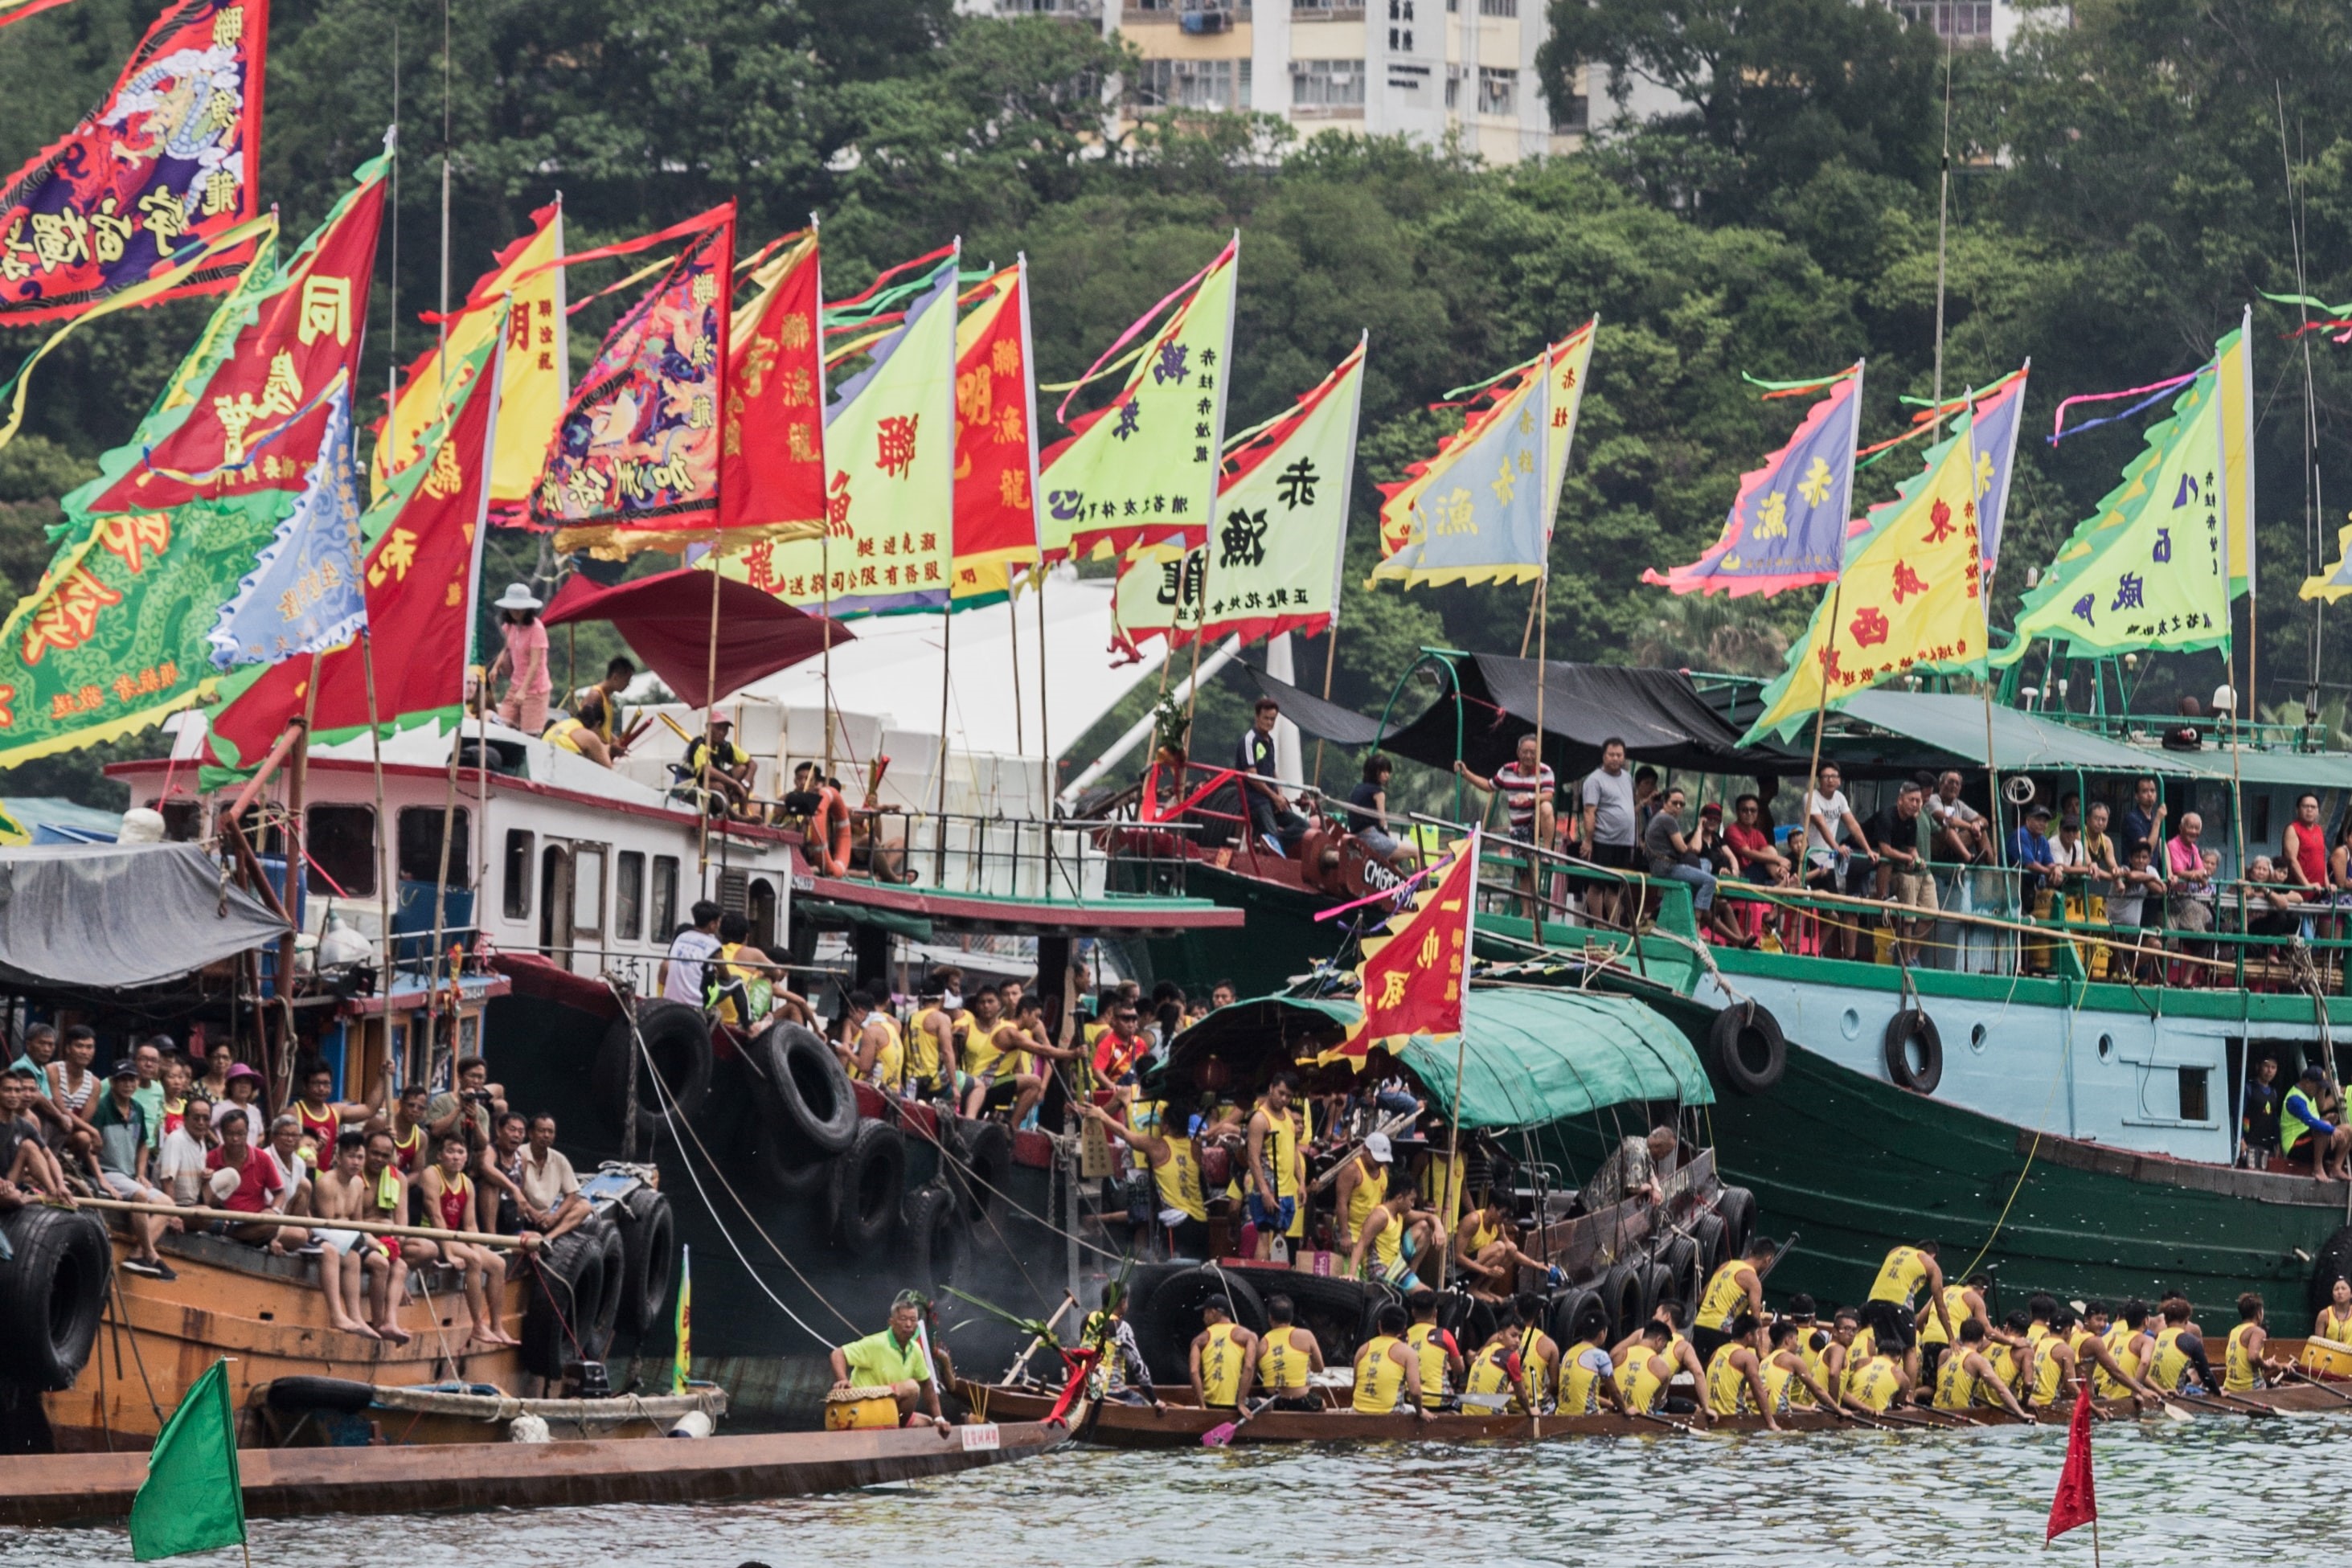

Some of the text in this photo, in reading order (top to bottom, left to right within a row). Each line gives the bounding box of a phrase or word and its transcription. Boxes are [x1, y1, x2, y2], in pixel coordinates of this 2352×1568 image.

[781, 312, 821, 464] 聯漁龍
[992, 338, 1031, 510] 聯漁龍
